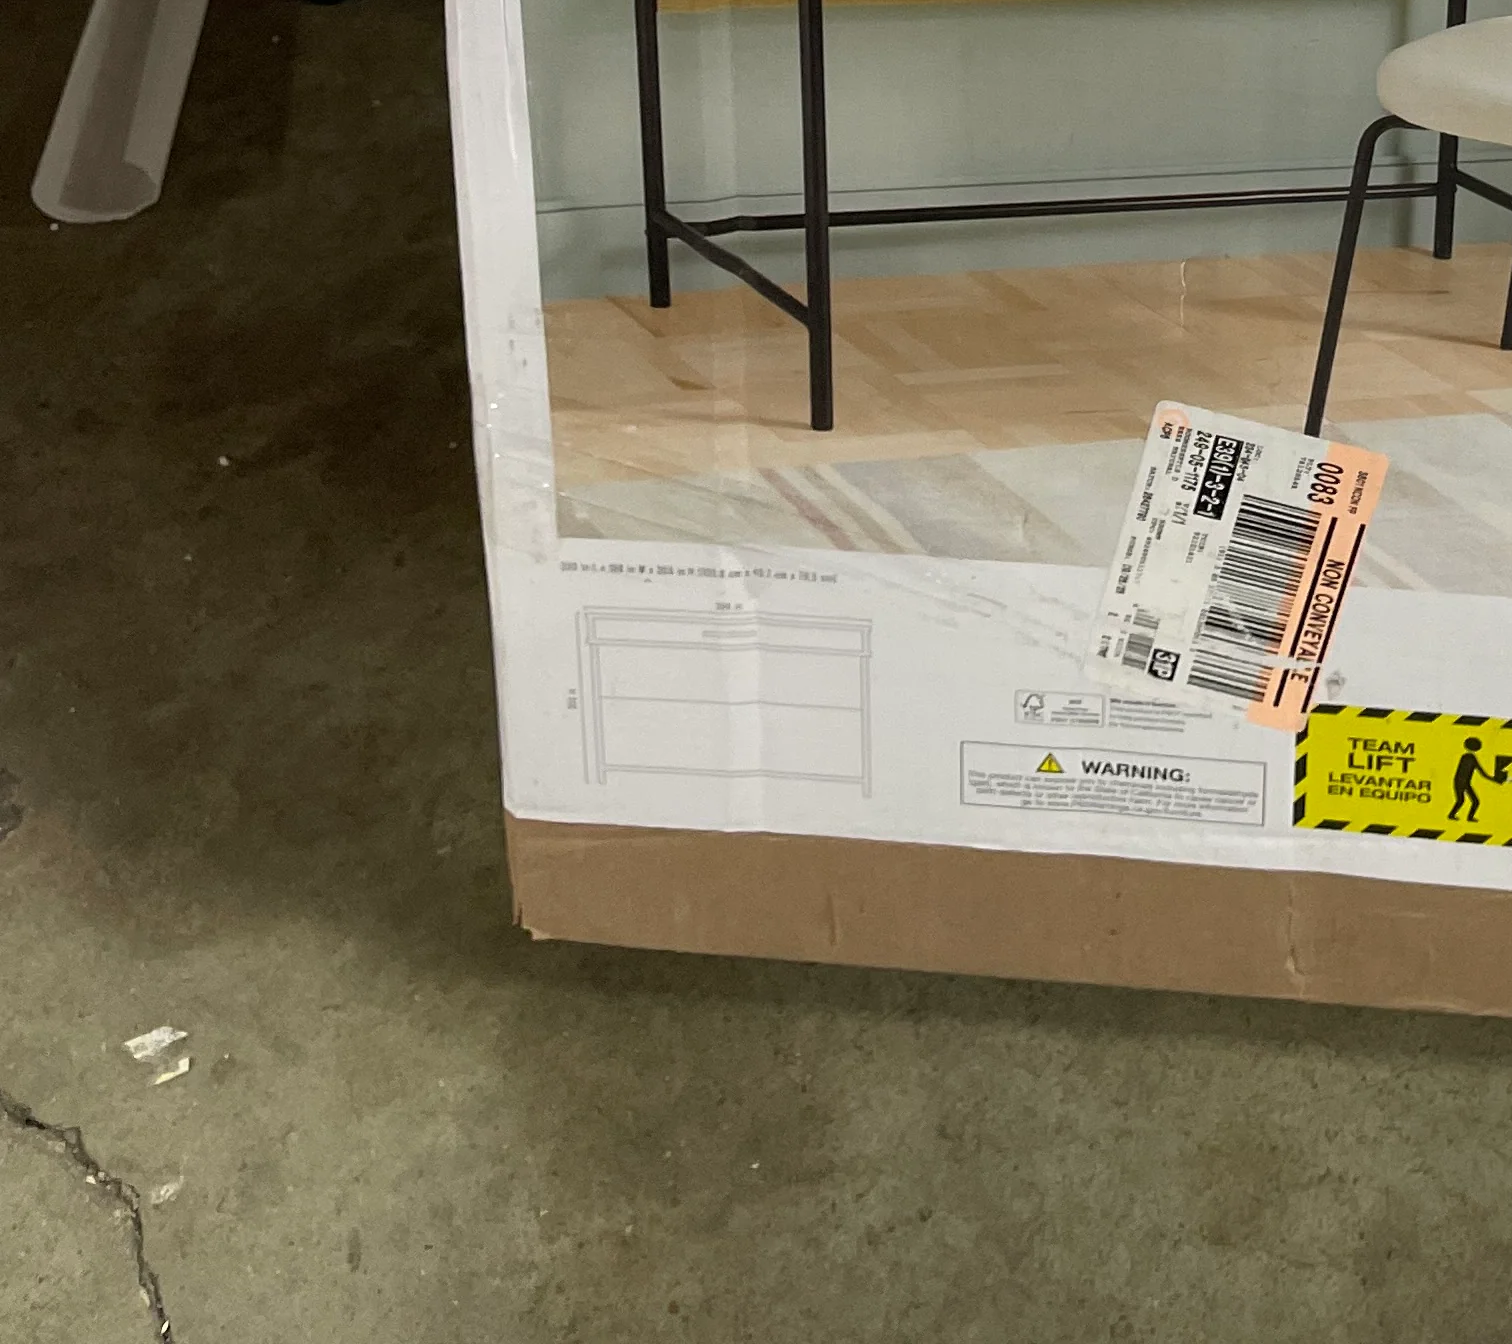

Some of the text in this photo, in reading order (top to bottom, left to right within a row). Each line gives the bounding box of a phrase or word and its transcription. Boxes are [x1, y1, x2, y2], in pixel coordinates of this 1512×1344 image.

[1180, 430, 1212, 492] 249-05-1175
[1306, 460, 1344, 507] 0083
[1289, 558, 1344, 684] NON CONVEYAE
[1347, 737, 1415, 755] TEAM
[1081, 760, 1190, 783] WARNING:
[1348, 753, 1416, 774] LIFT
[1328, 772, 1432, 791] LEVANTAR
[1328, 785, 1432, 804] EN EQUIPO
